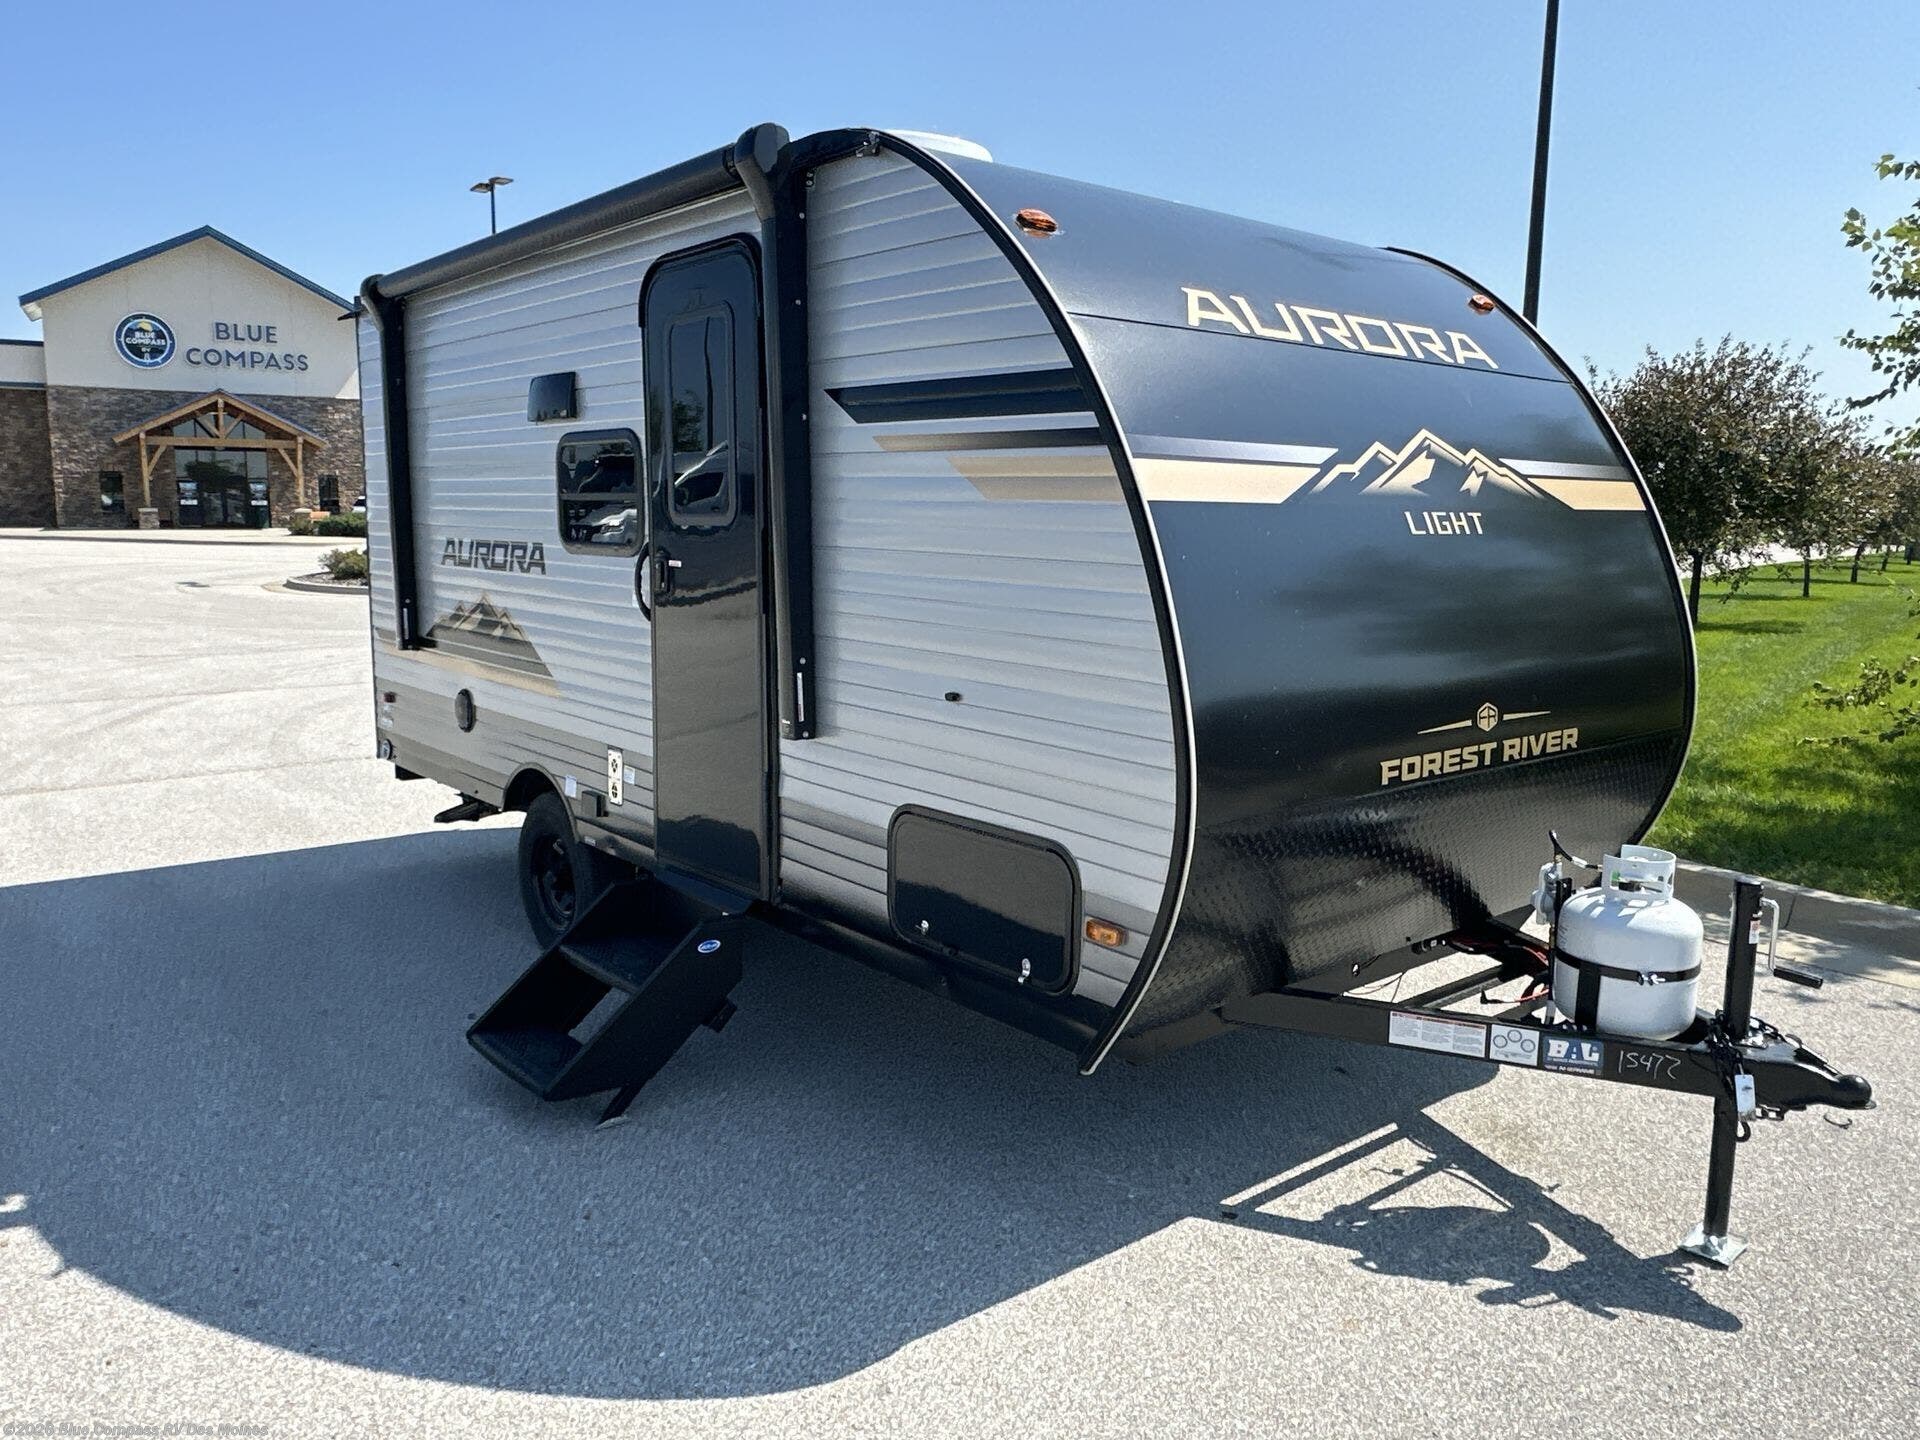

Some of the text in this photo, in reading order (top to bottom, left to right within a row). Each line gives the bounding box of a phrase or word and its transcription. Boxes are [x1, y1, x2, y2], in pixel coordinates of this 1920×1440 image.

[215, 322, 278, 344] BLUE
[1181, 287, 1499, 369] AURORA
[186, 347, 309, 371] COMPASS
[1404, 511, 1484, 535] LIGHT
[441, 537, 546, 575] AURORA
[1380, 727, 1579, 786] FOREST RIVER
